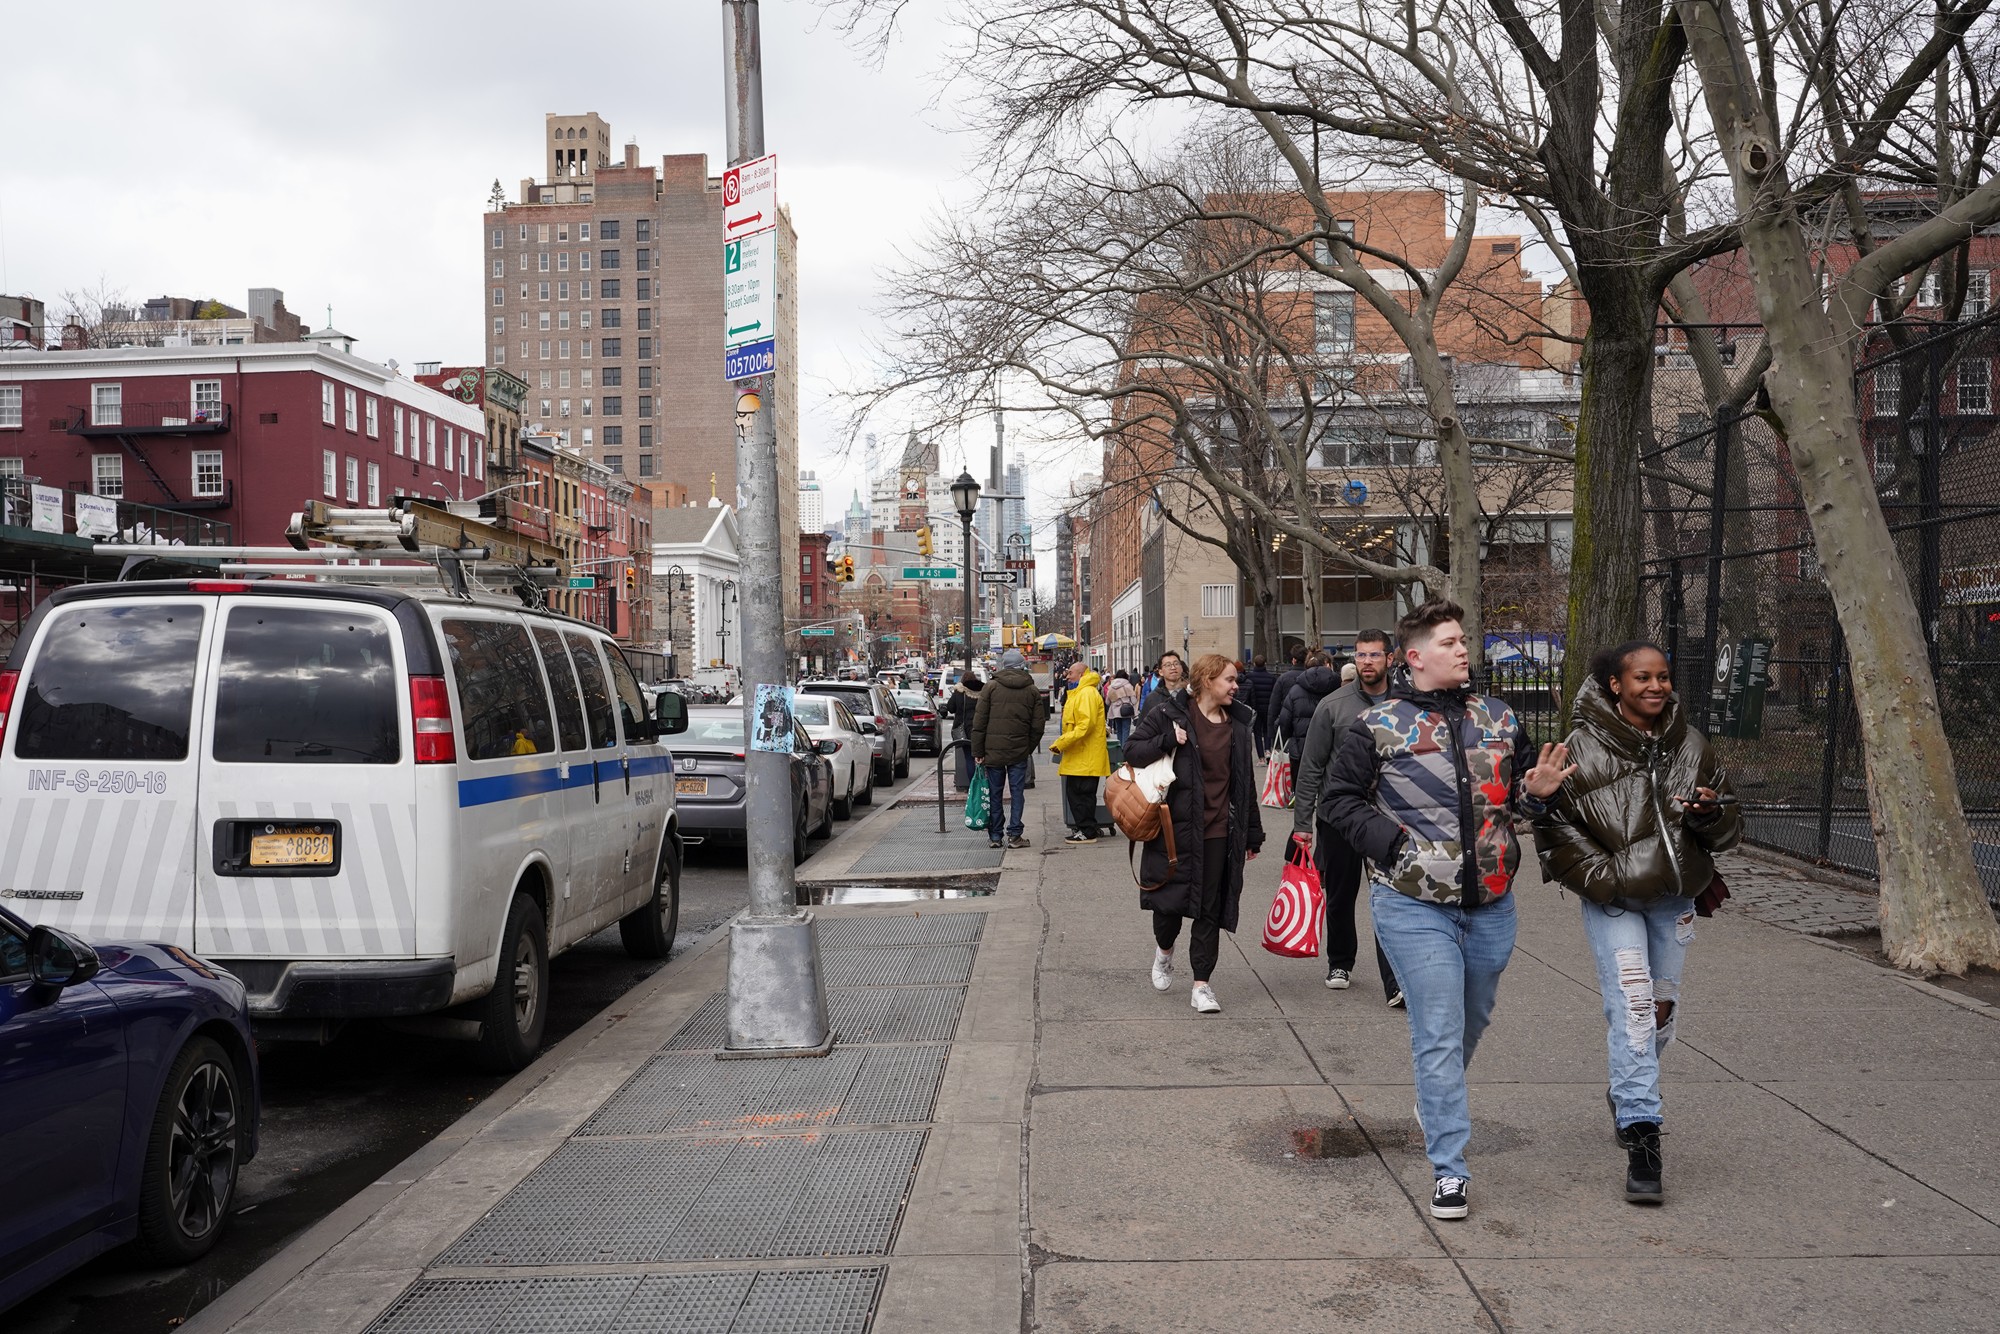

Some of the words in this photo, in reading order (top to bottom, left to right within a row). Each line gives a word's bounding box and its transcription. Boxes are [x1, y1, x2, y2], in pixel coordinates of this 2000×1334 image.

[742, 174, 750, 183] 8am
[754, 167, 770, 179] 8:30am
[742, 185, 755, 197] Except
[756, 181, 770, 192] Sunday
[729, 243, 737, 270] 2
[742, 259, 757, 271] parking
[728, 283, 744, 296] 8:30am
[748, 279, 760, 290] 10pm
[728, 296, 742, 310] Except
[744, 293, 760, 305] Sunday
[727, 353, 762, 377] 105700
[933, 569, 941, 577] St
[1019, 598, 1031, 607] 25
[28, 769, 167, 794] INF-S-250-18
[17, 890, 83, 900] EXPRESS
